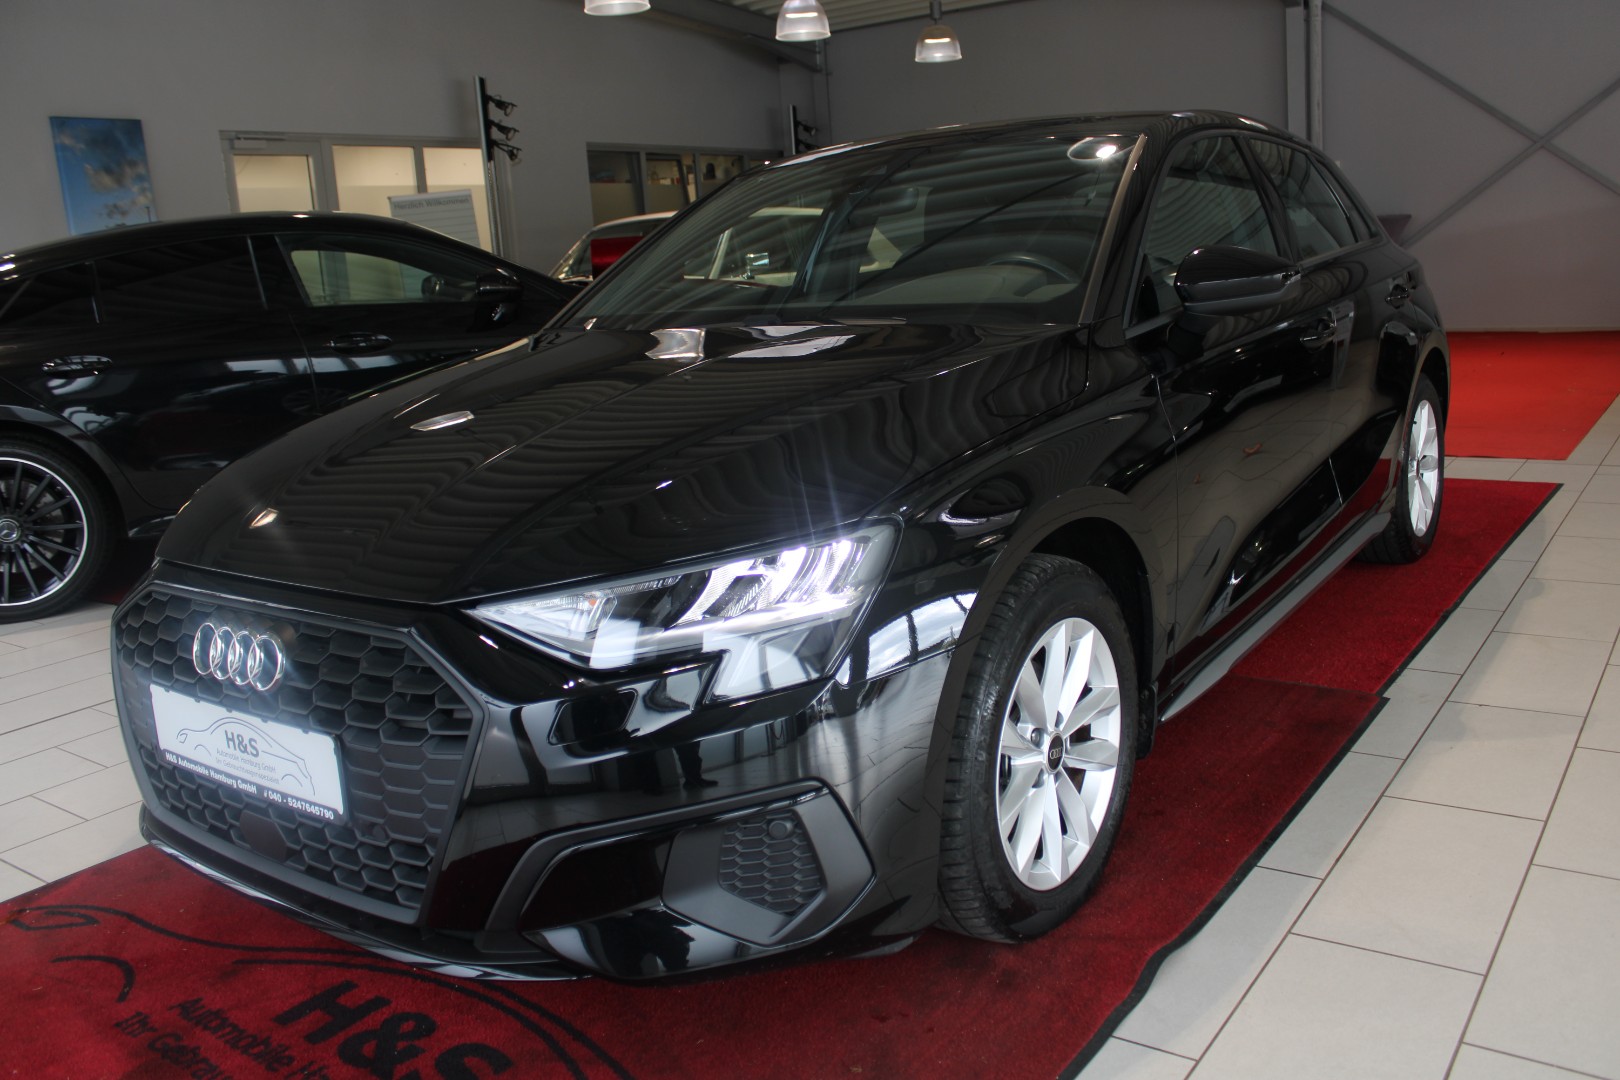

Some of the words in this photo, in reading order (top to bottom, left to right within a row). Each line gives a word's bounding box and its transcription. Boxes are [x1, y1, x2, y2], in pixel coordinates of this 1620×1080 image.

[393, 200, 424, 210] Herzlich
[425, 197, 470, 207] Willkommen
[225, 730, 260, 758] H&S
[165, 751, 178, 763] H&S
[178, 757, 209, 776] Automobile
[209, 769, 237, 789] Hamburg
[237, 779, 257, 794] GmbH
[268, 791, 282, 803] 040
[287, 797, 334, 820] 5247645790
[114, 1011, 158, 1038] Ihr
[166, 996, 296, 1073] Automobile
